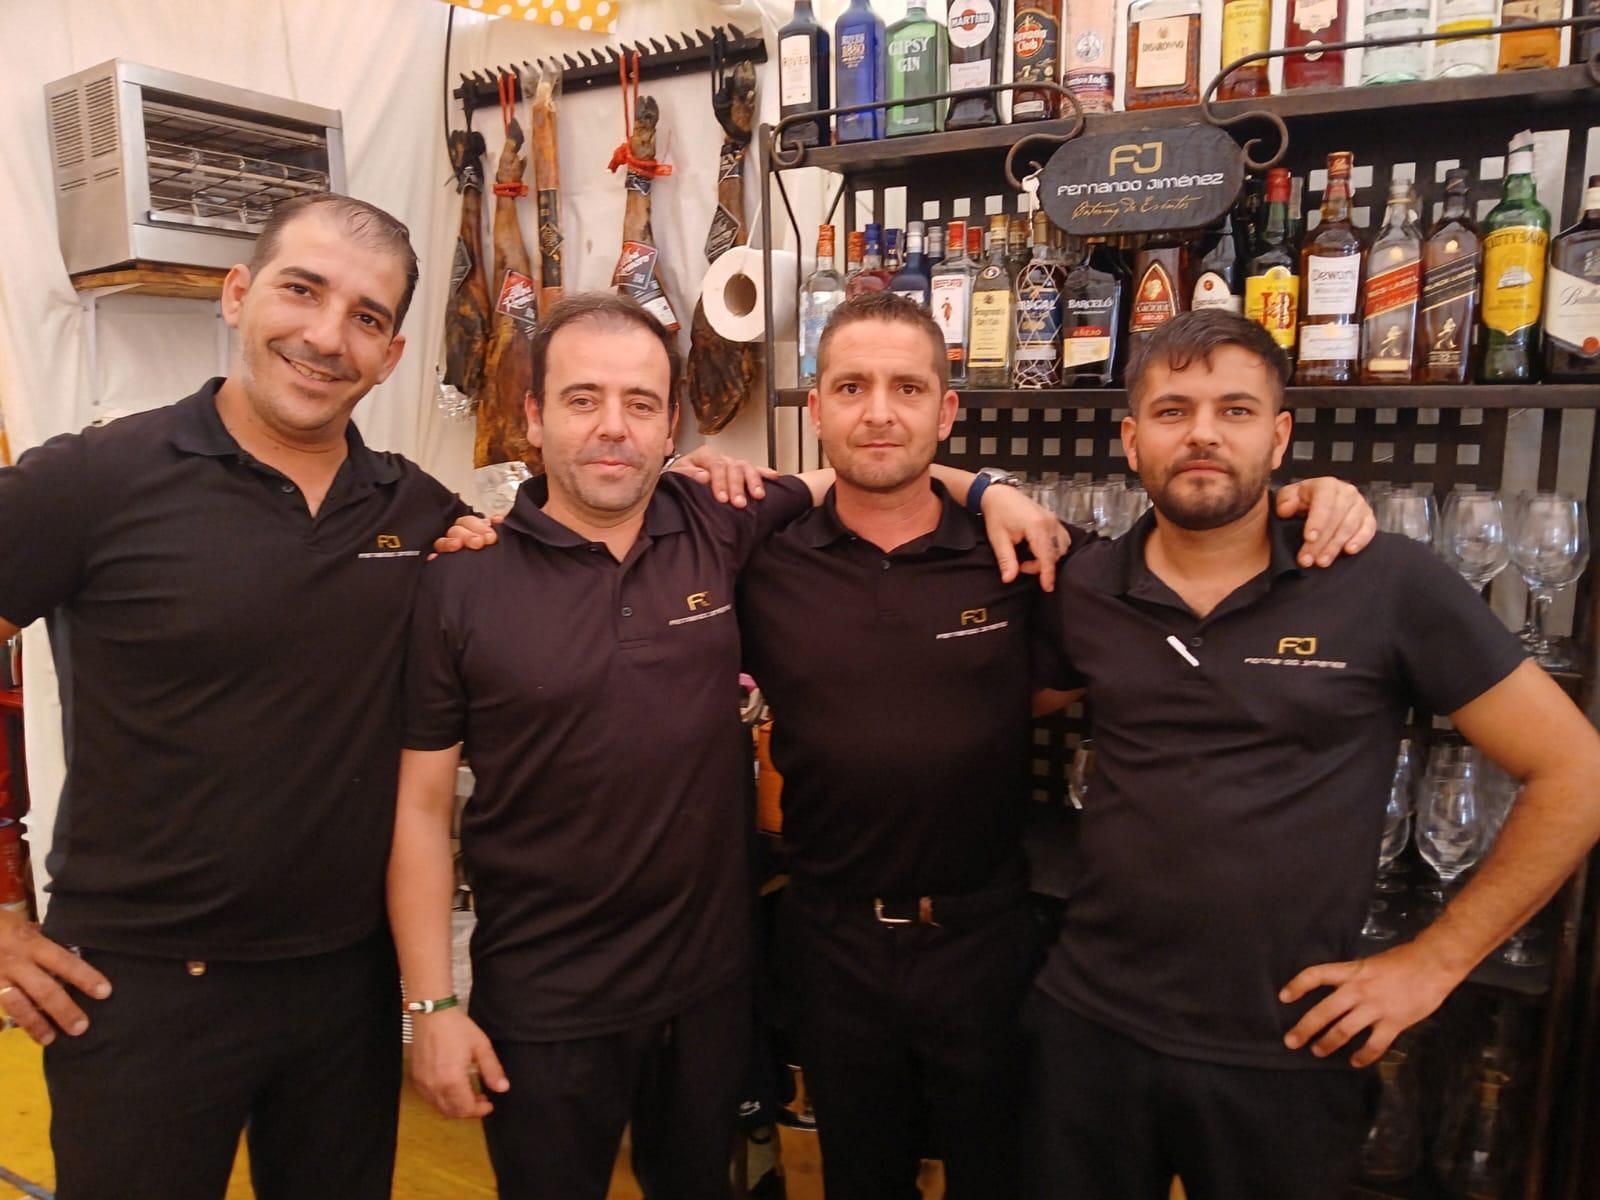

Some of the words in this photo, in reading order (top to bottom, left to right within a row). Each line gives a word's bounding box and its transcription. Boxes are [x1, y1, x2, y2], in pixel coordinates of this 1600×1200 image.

[887, 36, 929, 57] GIPSY
[897, 55, 922, 73] GIN
[1108, 141, 1164, 177] FJ
[960, 607, 987, 626] FJ
[1277, 636, 1318, 655] FJ
